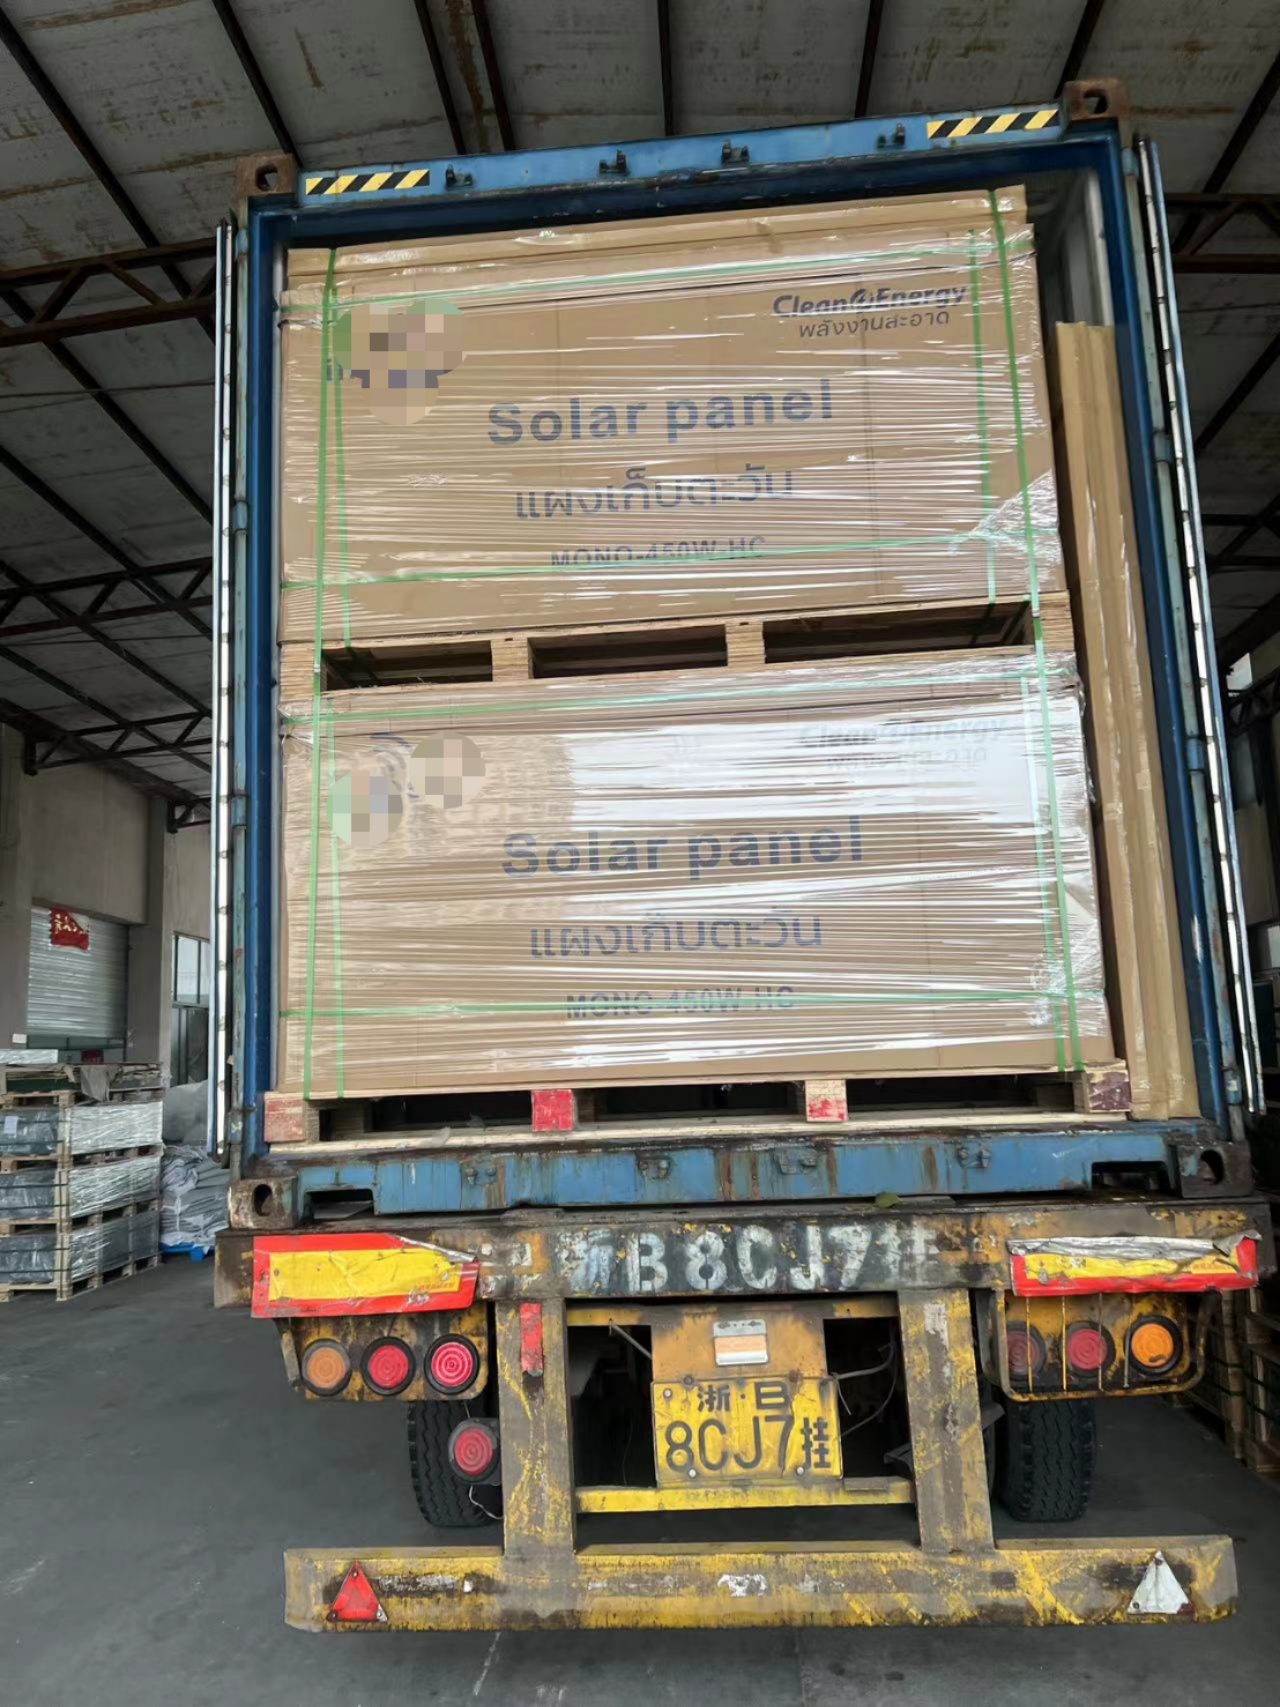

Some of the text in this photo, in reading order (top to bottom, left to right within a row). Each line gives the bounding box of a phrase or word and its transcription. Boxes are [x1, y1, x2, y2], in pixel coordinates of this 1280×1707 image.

[773, 286, 967, 318] Clean Energy
[799, 310, 950, 338] พลังงานสะอาด
[488, 378, 833, 445] Solar panel
[502, 815, 863, 880] Solar panel
[566, 985, 795, 1020] MONO450WHC
[664, 1414, 832, 1473] 8CJ7挂
